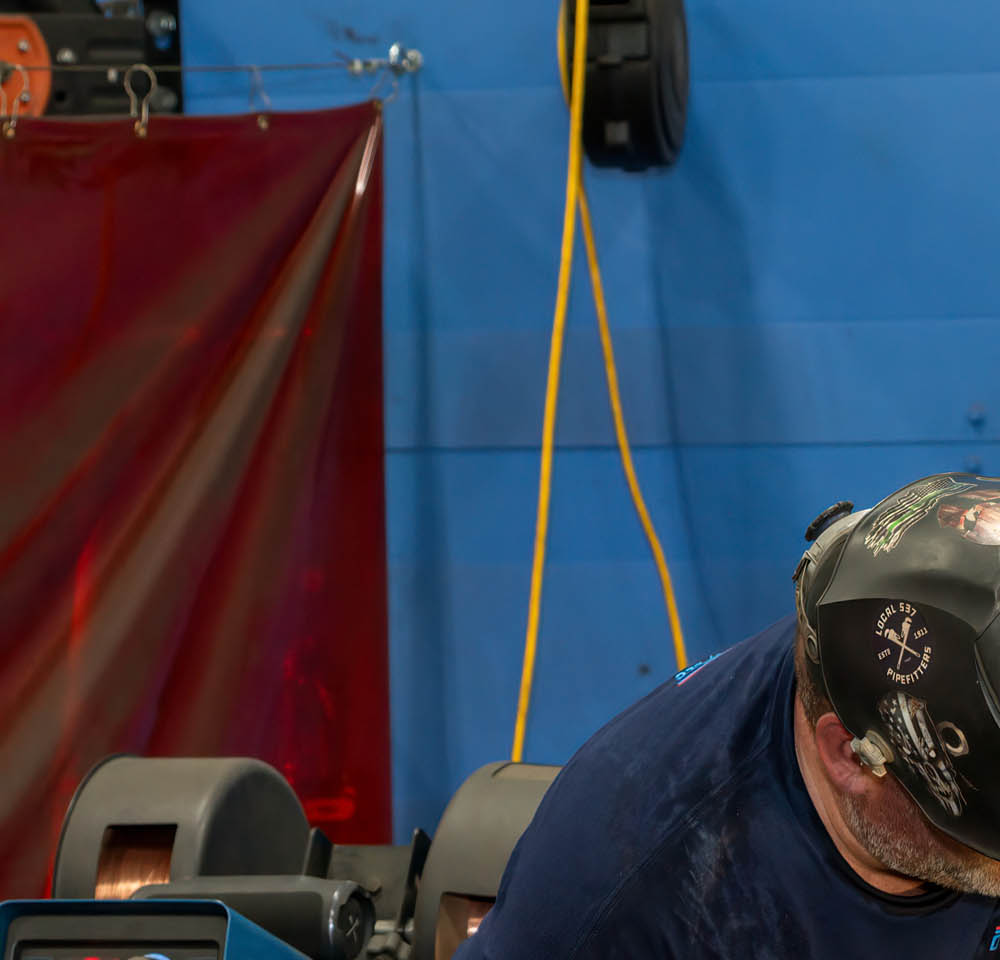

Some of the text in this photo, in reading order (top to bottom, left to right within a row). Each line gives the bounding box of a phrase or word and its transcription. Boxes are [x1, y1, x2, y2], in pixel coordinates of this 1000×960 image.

[875, 602, 917, 636] LOCAL 537
[887, 646, 932, 685] PIPEFITTERS
